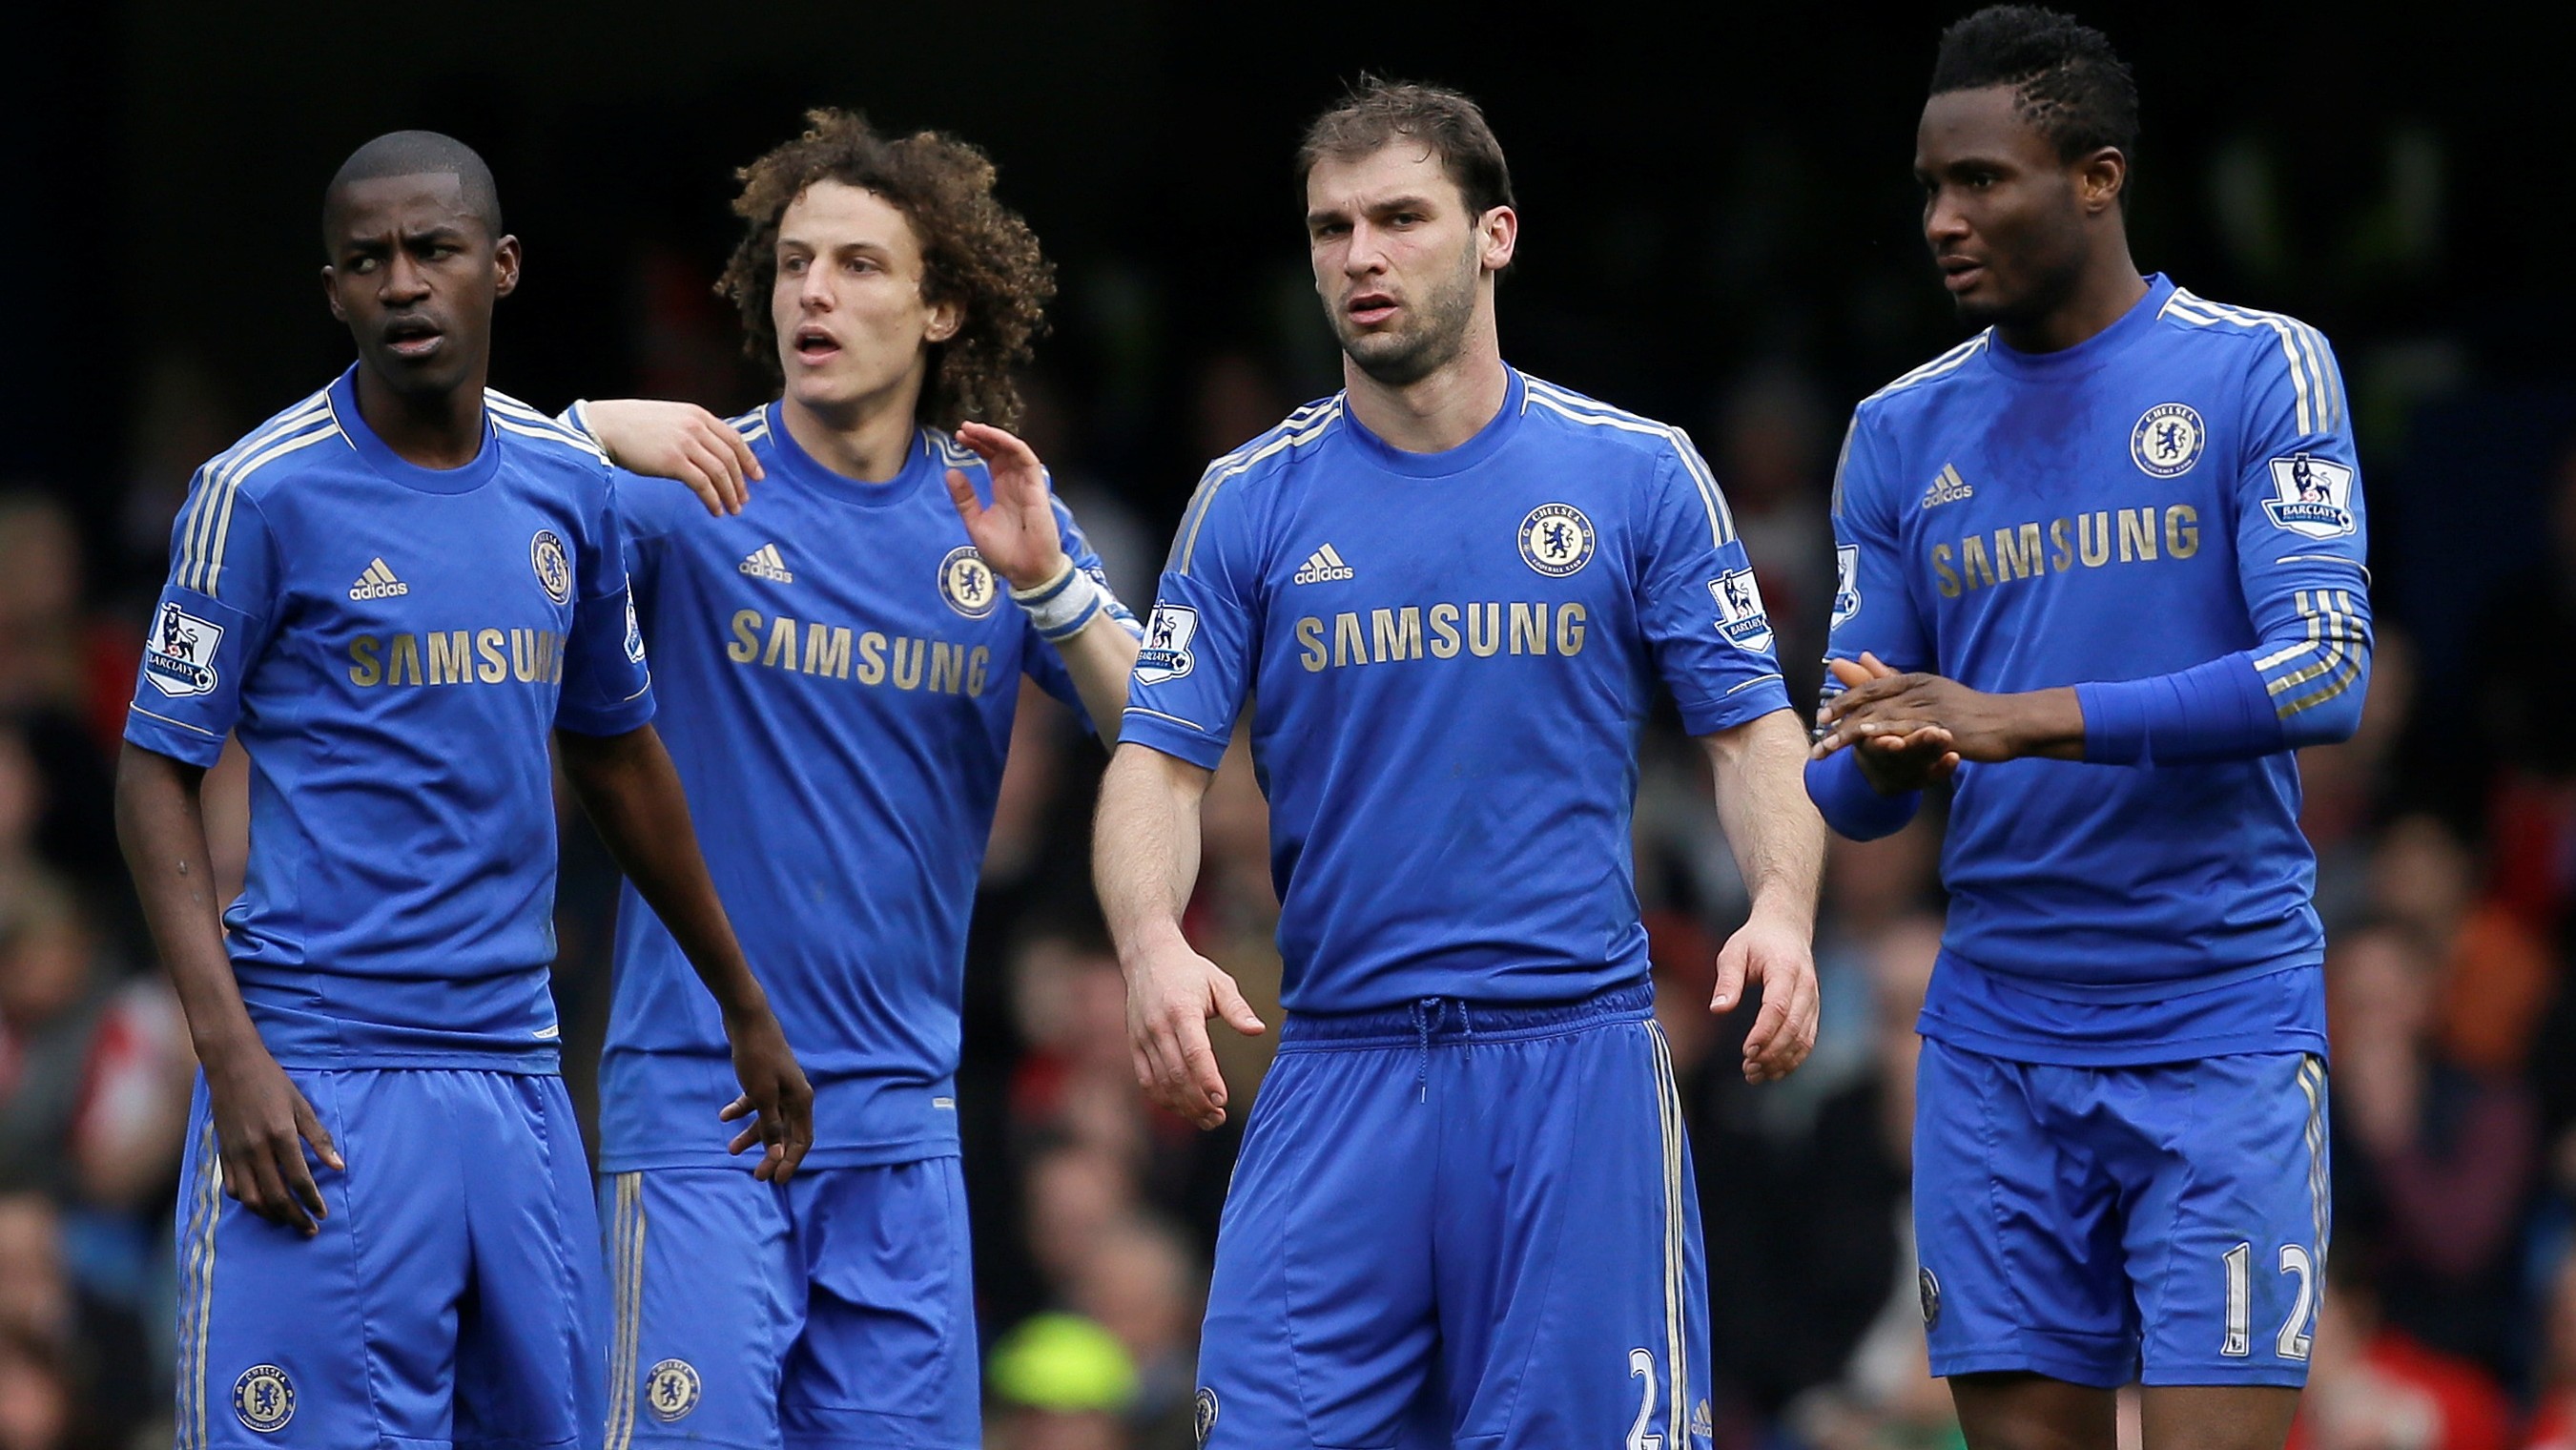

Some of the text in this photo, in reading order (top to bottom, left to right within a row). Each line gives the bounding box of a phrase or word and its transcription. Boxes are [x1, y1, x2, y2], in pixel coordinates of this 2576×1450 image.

[1922, 485, 1973, 508] adidas
[1532, 507, 1580, 523] CHELSEA
[2282, 505, 2337, 518] BARCLAYS
[1931, 504, 2200, 598] SAMSUNG
[738, 562, 793, 584] adidas
[1293, 566, 1354, 586] adidas
[349, 582, 409, 601] adidas
[1296, 602, 1587, 673] SAMSUNG
[727, 610, 989, 698] SAMSUNG
[2221, 1242, 2313, 1361] 12
[1626, 1348, 1663, 1450] 2
